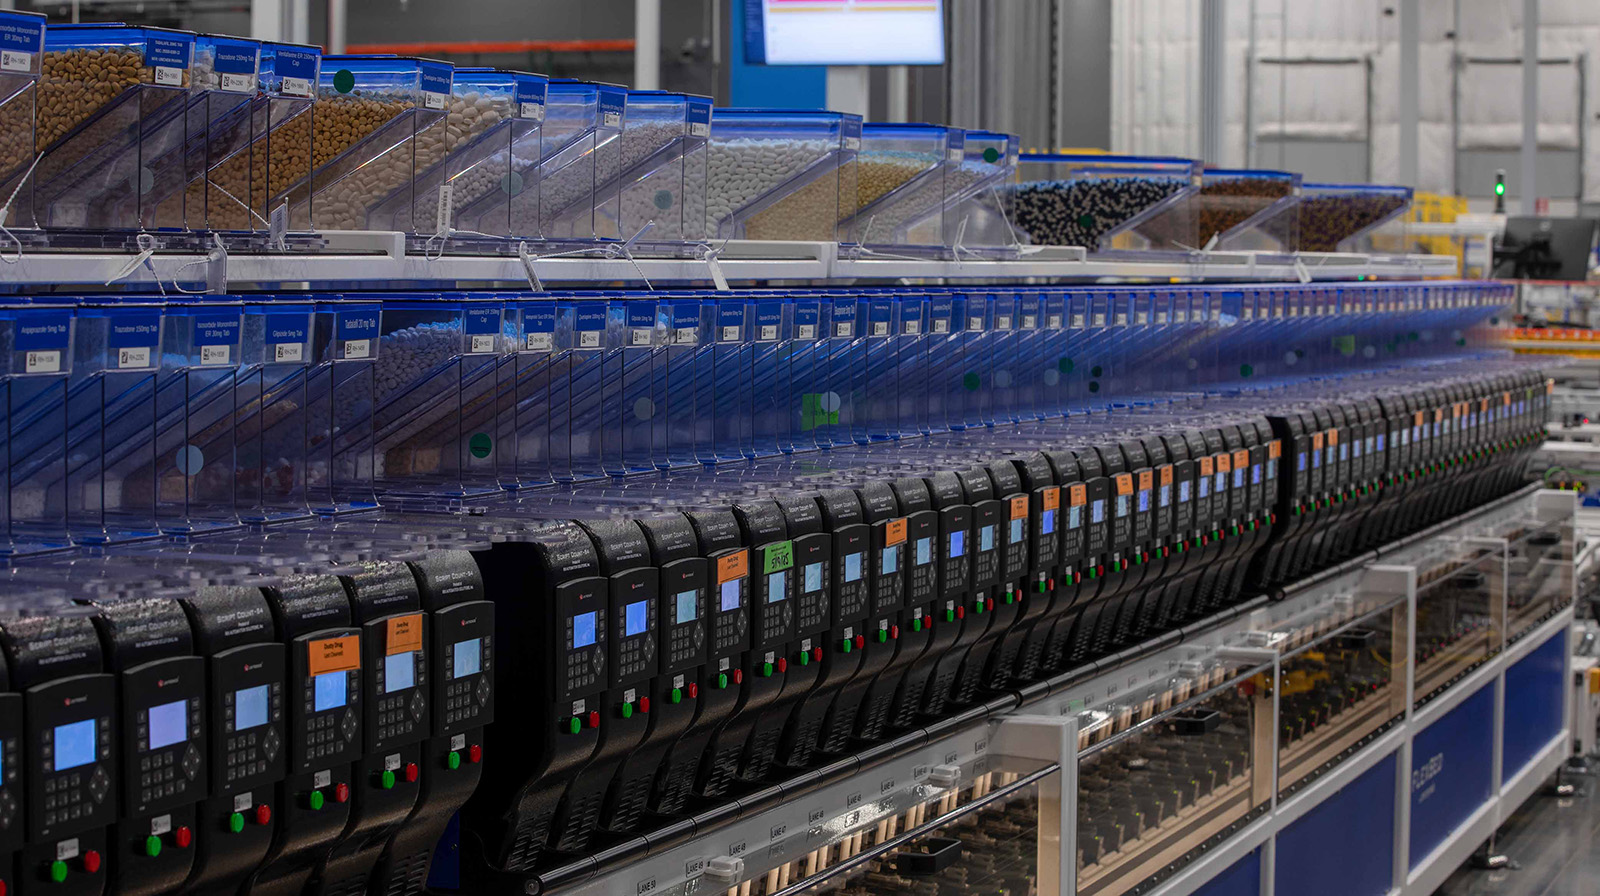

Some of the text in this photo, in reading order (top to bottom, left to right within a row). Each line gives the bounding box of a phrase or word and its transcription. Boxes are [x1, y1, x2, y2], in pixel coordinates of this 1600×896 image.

[687, 863, 698, 875] LANE
[639, 879, 656, 894] LANE 50
